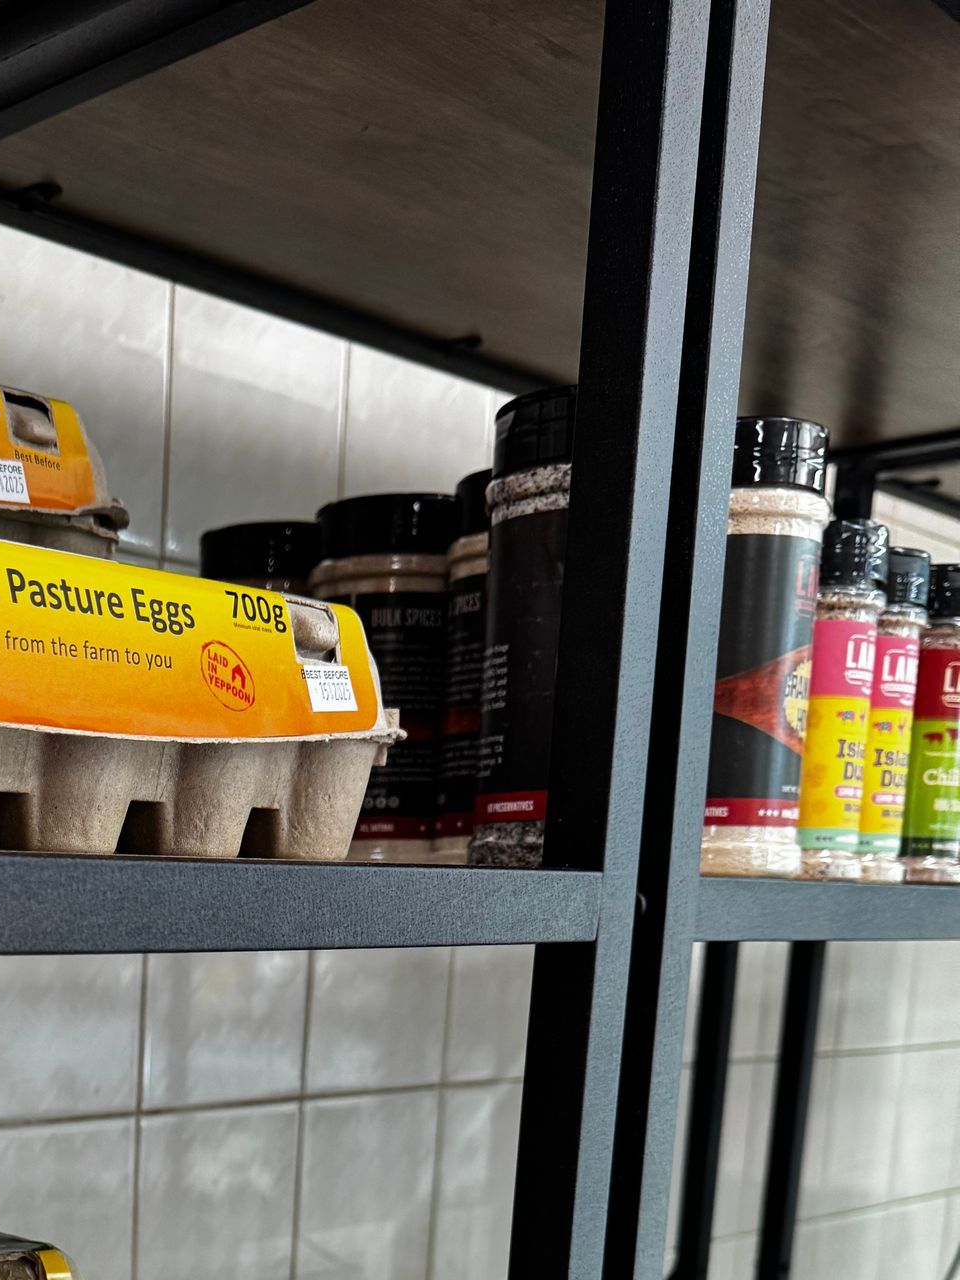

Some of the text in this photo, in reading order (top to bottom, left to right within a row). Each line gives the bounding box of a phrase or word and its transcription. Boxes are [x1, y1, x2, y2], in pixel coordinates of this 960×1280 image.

[14, 450, 61, 471] Best Before
[6, 567, 124, 619] Pasture
[130, 587, 195, 636] Eggs
[225, 590, 287, 633] 700g
[5, 630, 45, 655] from
[51, 637, 78, 658] the
[83, 640, 120, 664] farm
[125, 647, 141, 666] to
[145, 654, 173, 671] you
[208, 649, 228, 669] LAID
[207, 663, 218, 675] IN
[305, 669, 321, 679] BEST
[323, 670, 349, 680] BEFORE
[208, 674, 251, 704] YEPPOON
